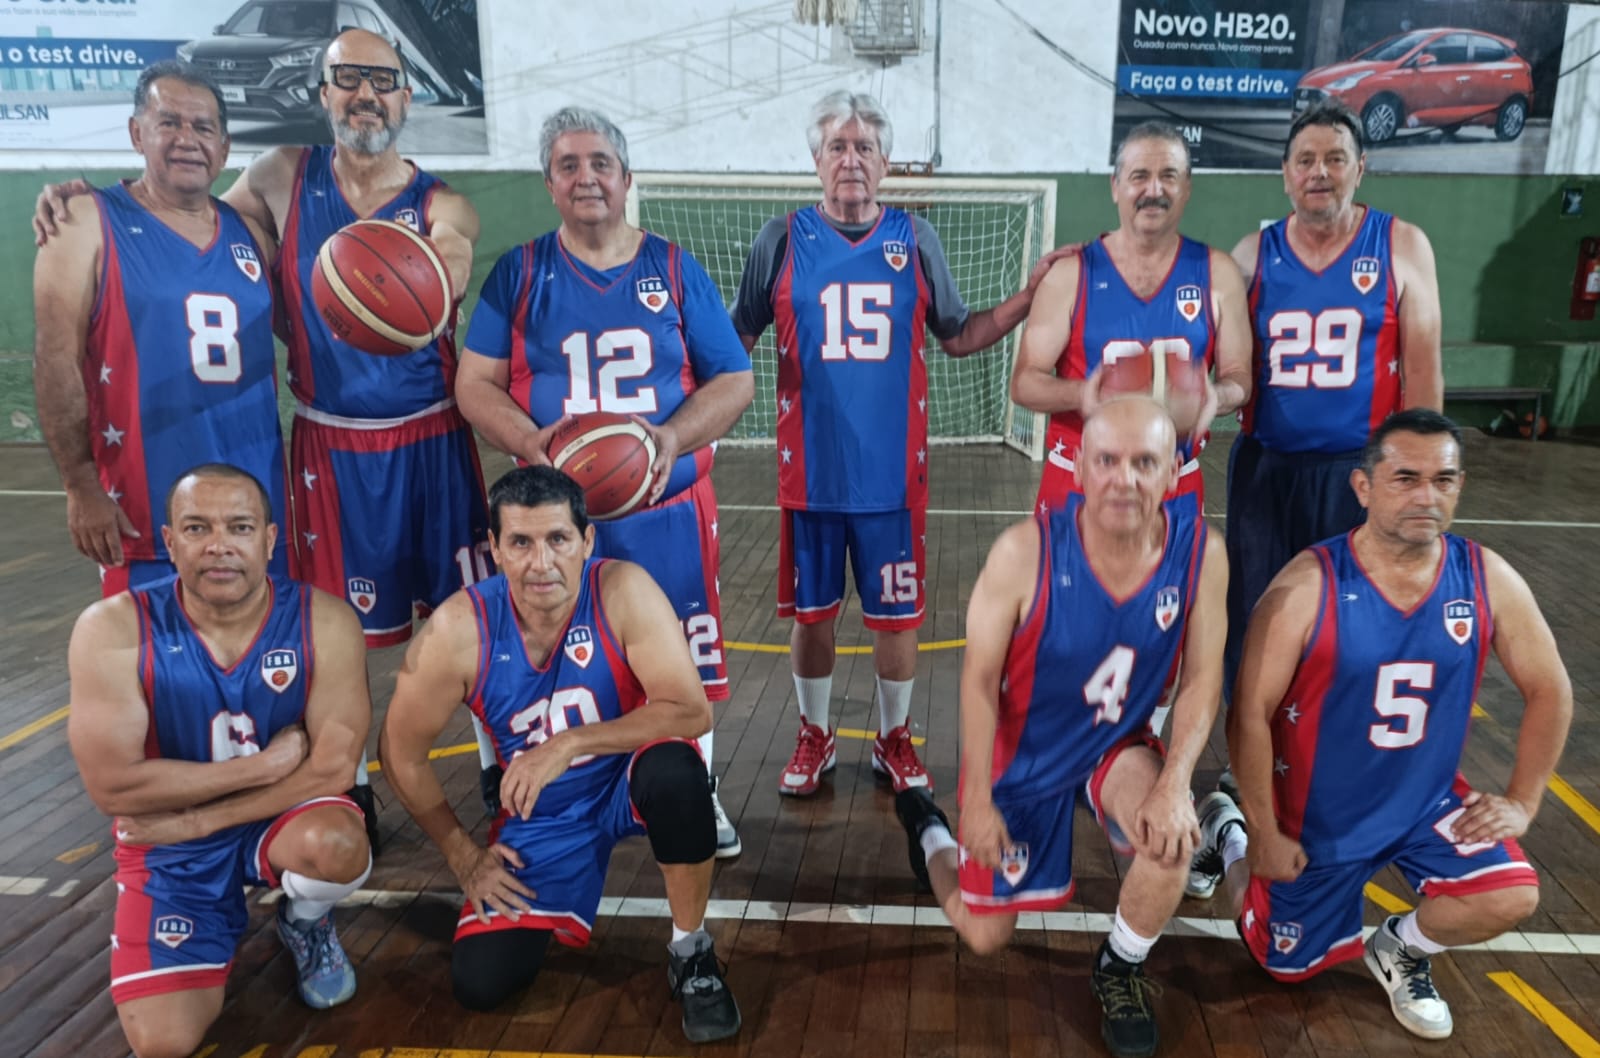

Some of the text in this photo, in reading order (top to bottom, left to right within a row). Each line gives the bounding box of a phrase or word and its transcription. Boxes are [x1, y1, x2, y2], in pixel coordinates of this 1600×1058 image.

[1134, 8, 1296, 41] Novo HB20.
[8, 47, 23, 63] o
[27, 44, 74, 63] test
[79, 44, 145, 65] drive.
[1130, 71, 1290, 94] Faça o test drive.
[185, 292, 243, 384] 8
[820, 282, 893, 361] 15
[1268, 307, 1364, 389] 29
[561, 327, 658, 414] 12
[880, 561, 918, 603] 15
[266, 654, 291, 666] FBA
[681, 613, 723, 667] 2
[1083, 644, 1137, 727] 4
[1369, 660, 1436, 750] 5
[210, 710, 261, 763] 6
